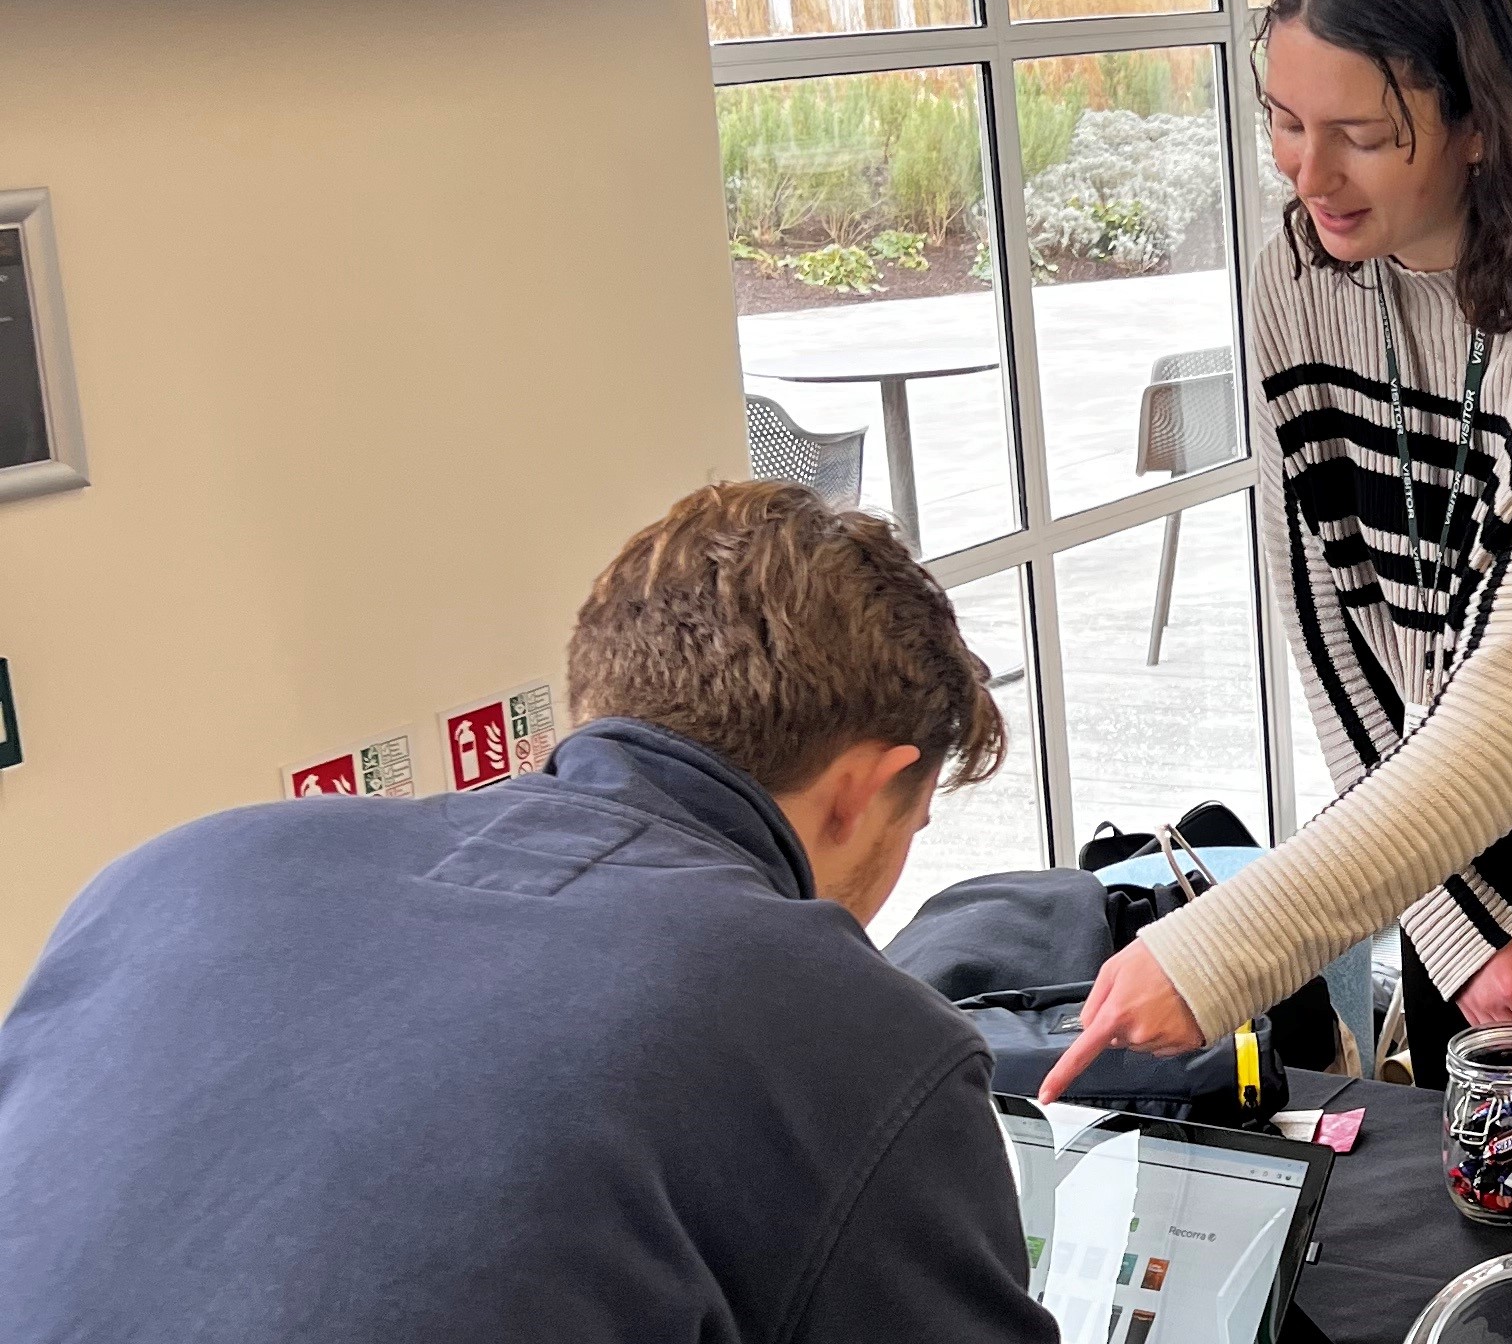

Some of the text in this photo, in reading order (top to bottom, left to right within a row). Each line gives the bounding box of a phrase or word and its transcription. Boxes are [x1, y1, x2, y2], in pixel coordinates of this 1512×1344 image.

[1471, 327, 1486, 365] VISIT
[1390, 377, 1405, 436] VISITOR
[1460, 388, 1476, 446] VISITOR
[1402, 462, 1415, 520] VISITOR
[1444, 471, 1463, 525] VISITOR
[1169, 1225, 1207, 1241] Recorra
